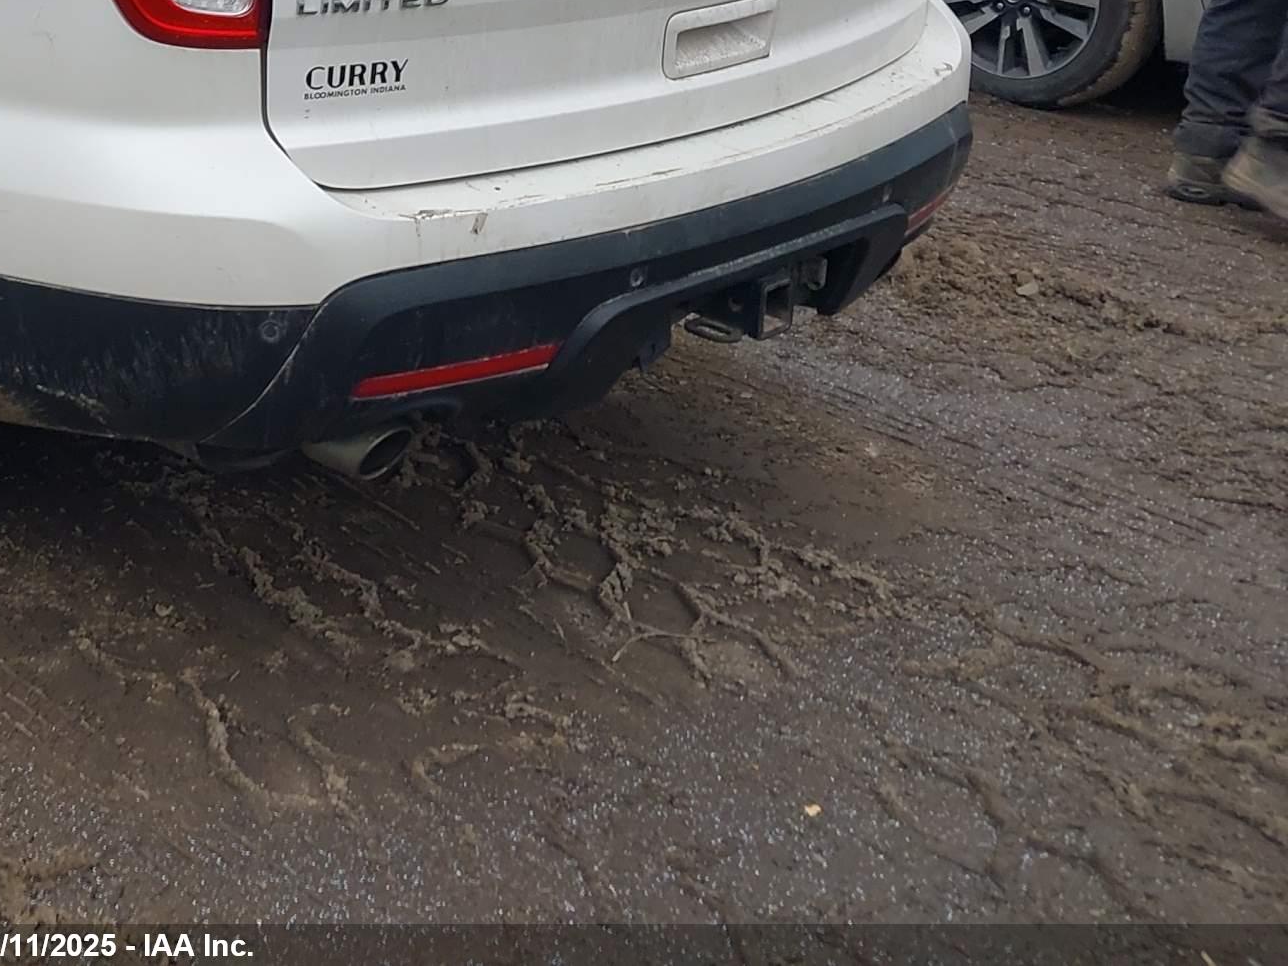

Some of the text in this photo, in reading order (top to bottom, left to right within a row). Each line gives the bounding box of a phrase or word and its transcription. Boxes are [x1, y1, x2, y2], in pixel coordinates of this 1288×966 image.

[305, 58, 409, 90] CURRY
[303, 84, 407, 101] BLOOMINGTON INDIANA
